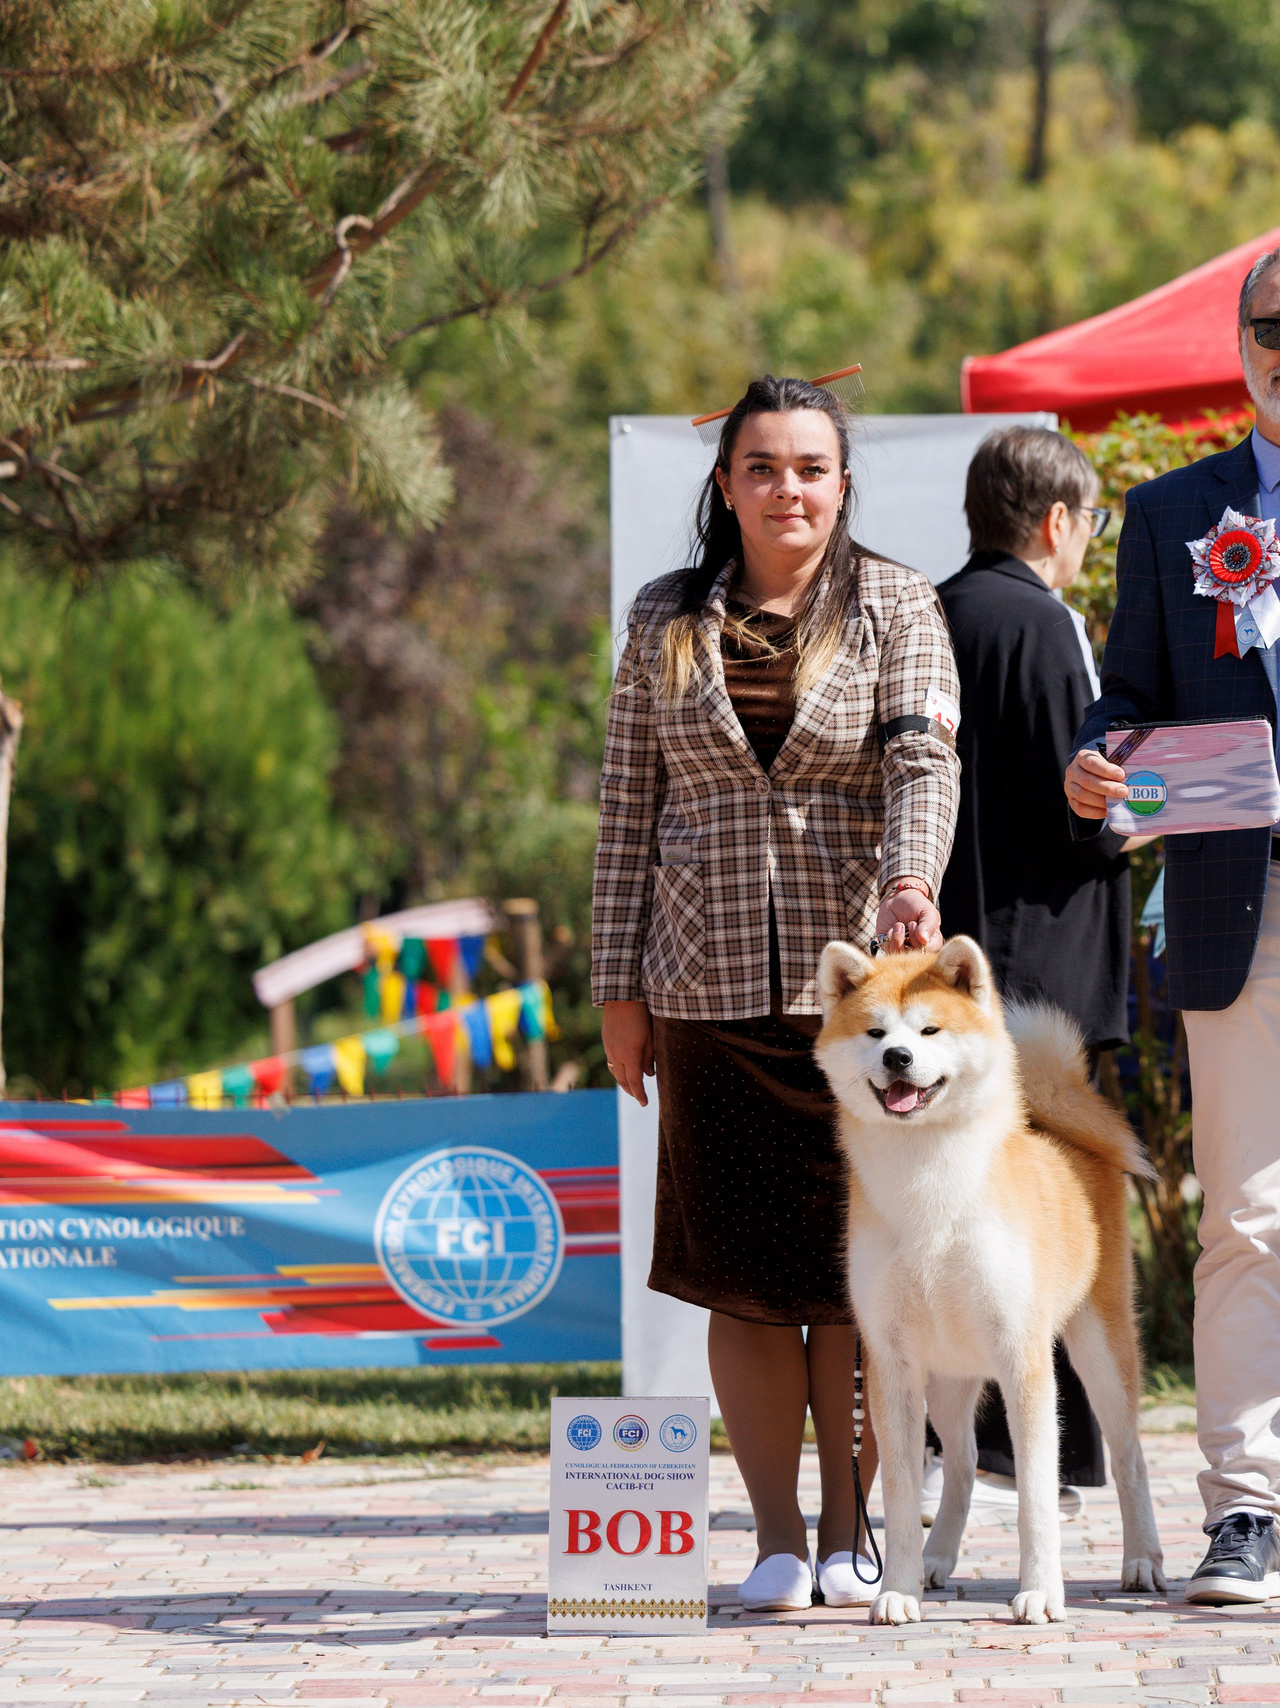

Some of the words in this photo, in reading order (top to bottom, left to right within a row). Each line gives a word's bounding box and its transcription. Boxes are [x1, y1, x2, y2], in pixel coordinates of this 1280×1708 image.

[1132, 788, 1159, 799] BOB
[58, 1216, 247, 1241] CYNOLOGIQUE
[436, 1220, 505, 1258] FCI
[577, 1429, 592, 1437] FCI
[622, 1428, 640, 1438] FCI
[565, 1472, 642, 1480] INTERNATIONAL
[644, 1472, 665, 1481] DOG
[666, 1472, 696, 1481] SHOW
[605, 1482, 654, 1491] CACIB-FCI
[562, 1509, 695, 1556] BOB
[602, 1583, 653, 1591] TASHKENT
